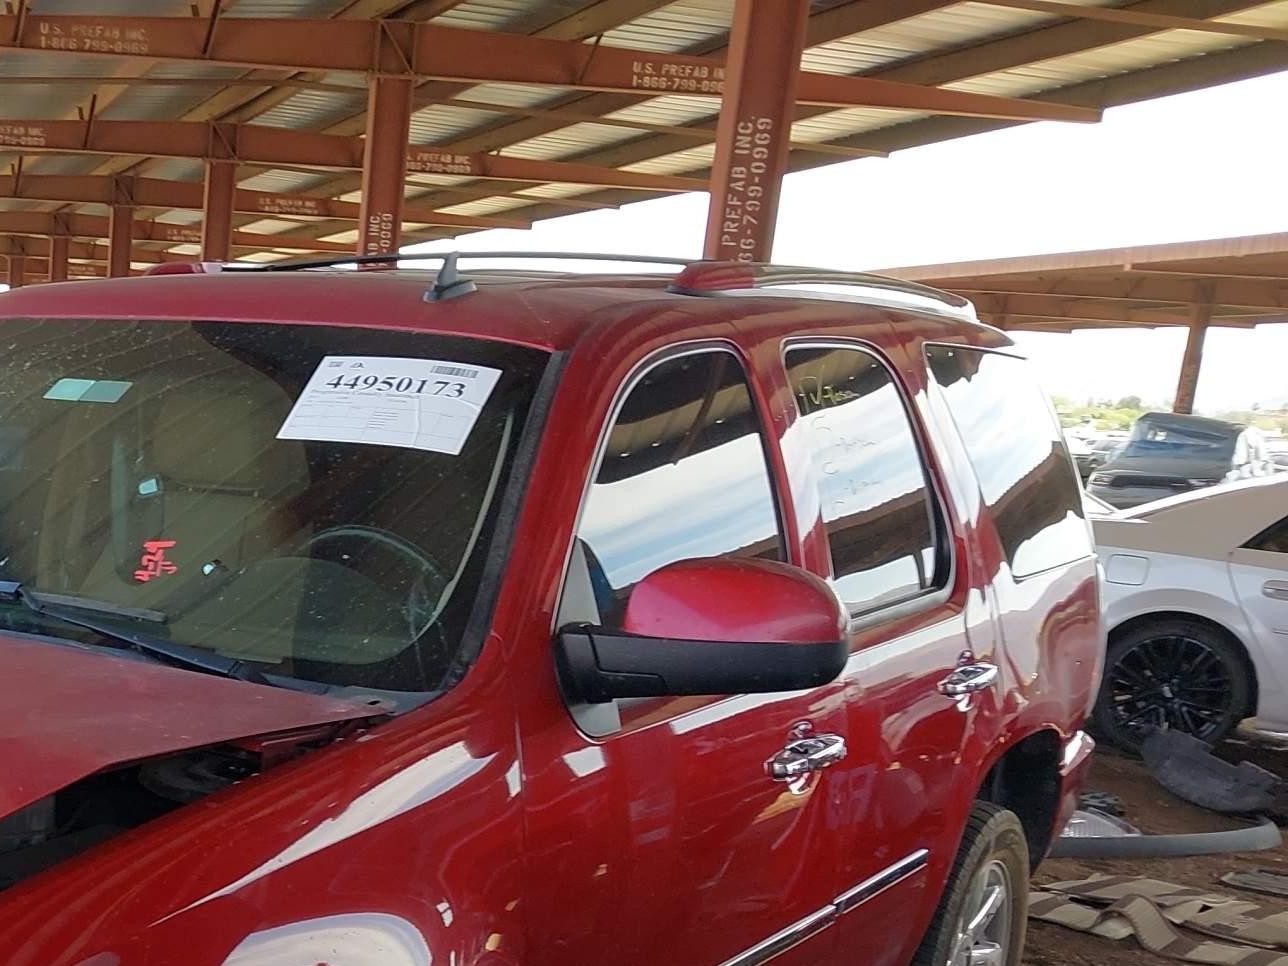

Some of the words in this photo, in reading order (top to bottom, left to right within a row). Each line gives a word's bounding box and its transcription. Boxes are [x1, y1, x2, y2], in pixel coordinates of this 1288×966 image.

[633, 61, 656, 75] U.S.
[662, 63, 709, 78] PREFAB
[713, 68, 726, 79] IN
[632, 74, 726, 93] 1-866-799-096
[721, 165, 748, 246] PREFAB
[735, 116, 756, 155] INC.
[325, 373, 466, 399] 44950173
